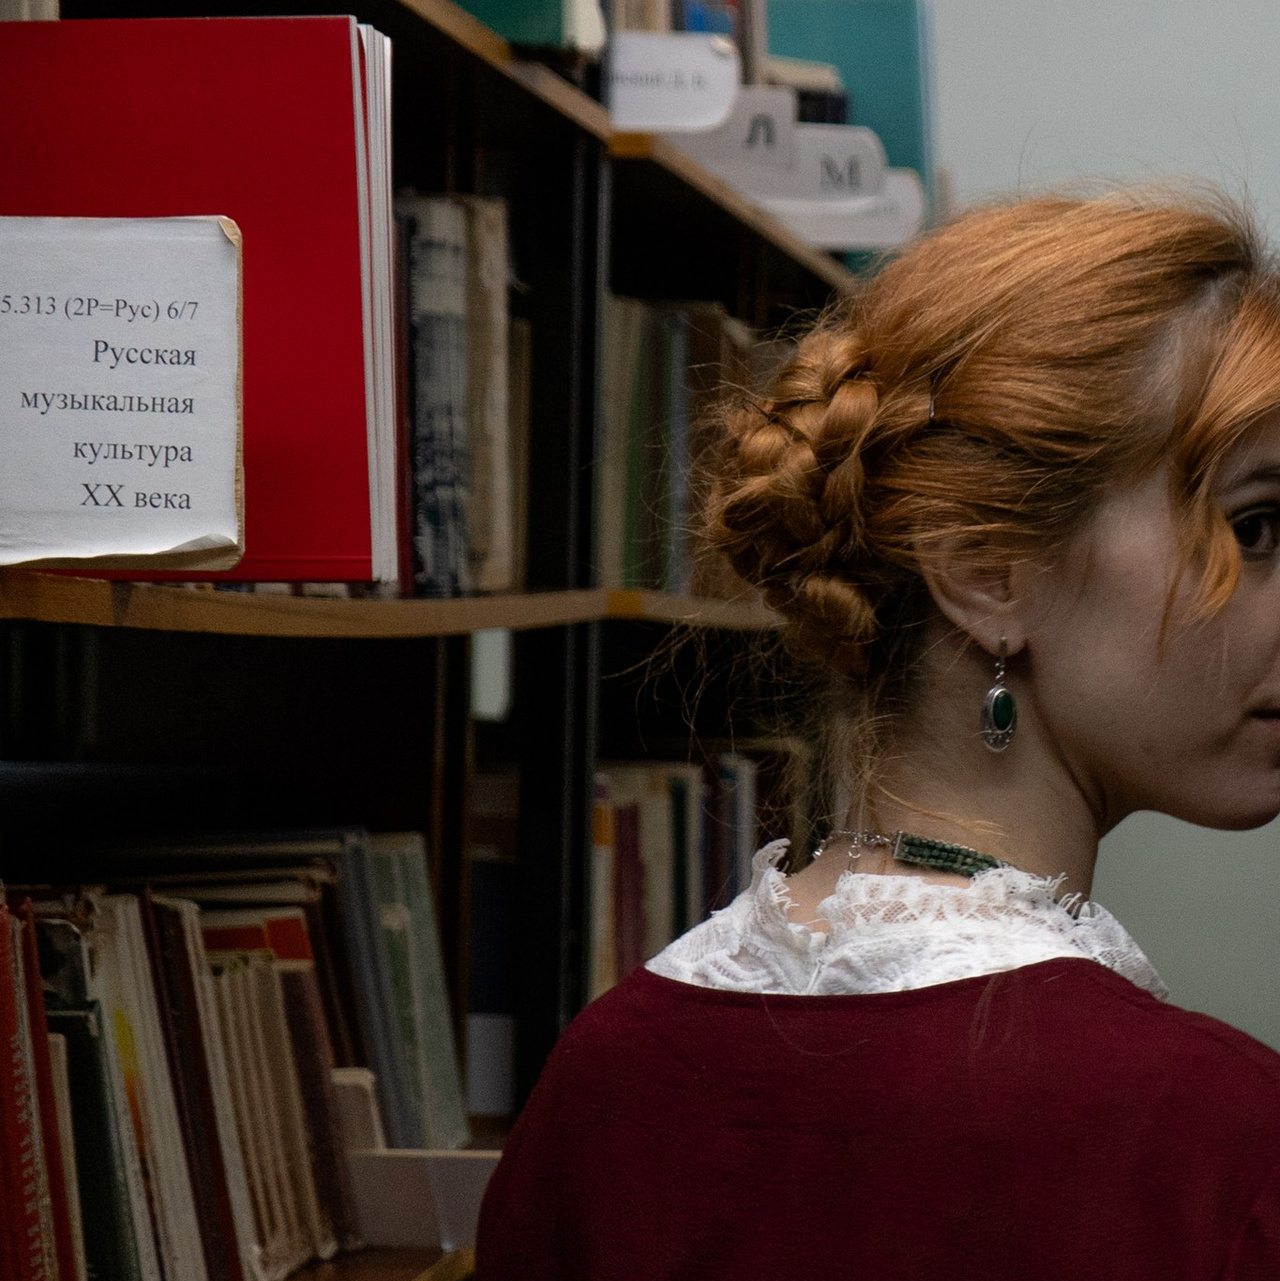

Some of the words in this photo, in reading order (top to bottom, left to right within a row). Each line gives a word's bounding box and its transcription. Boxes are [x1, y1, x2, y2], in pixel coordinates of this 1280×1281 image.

[819, 154, 863, 190] М
[0, 294, 56, 315] 5.313
[167, 300, 199, 320] 6/7
[92, 339, 197, 369] Русская
[20, 391, 194, 415] музыкальная
[73, 441, 193, 468] культура
[134, 487, 191, 510] века
